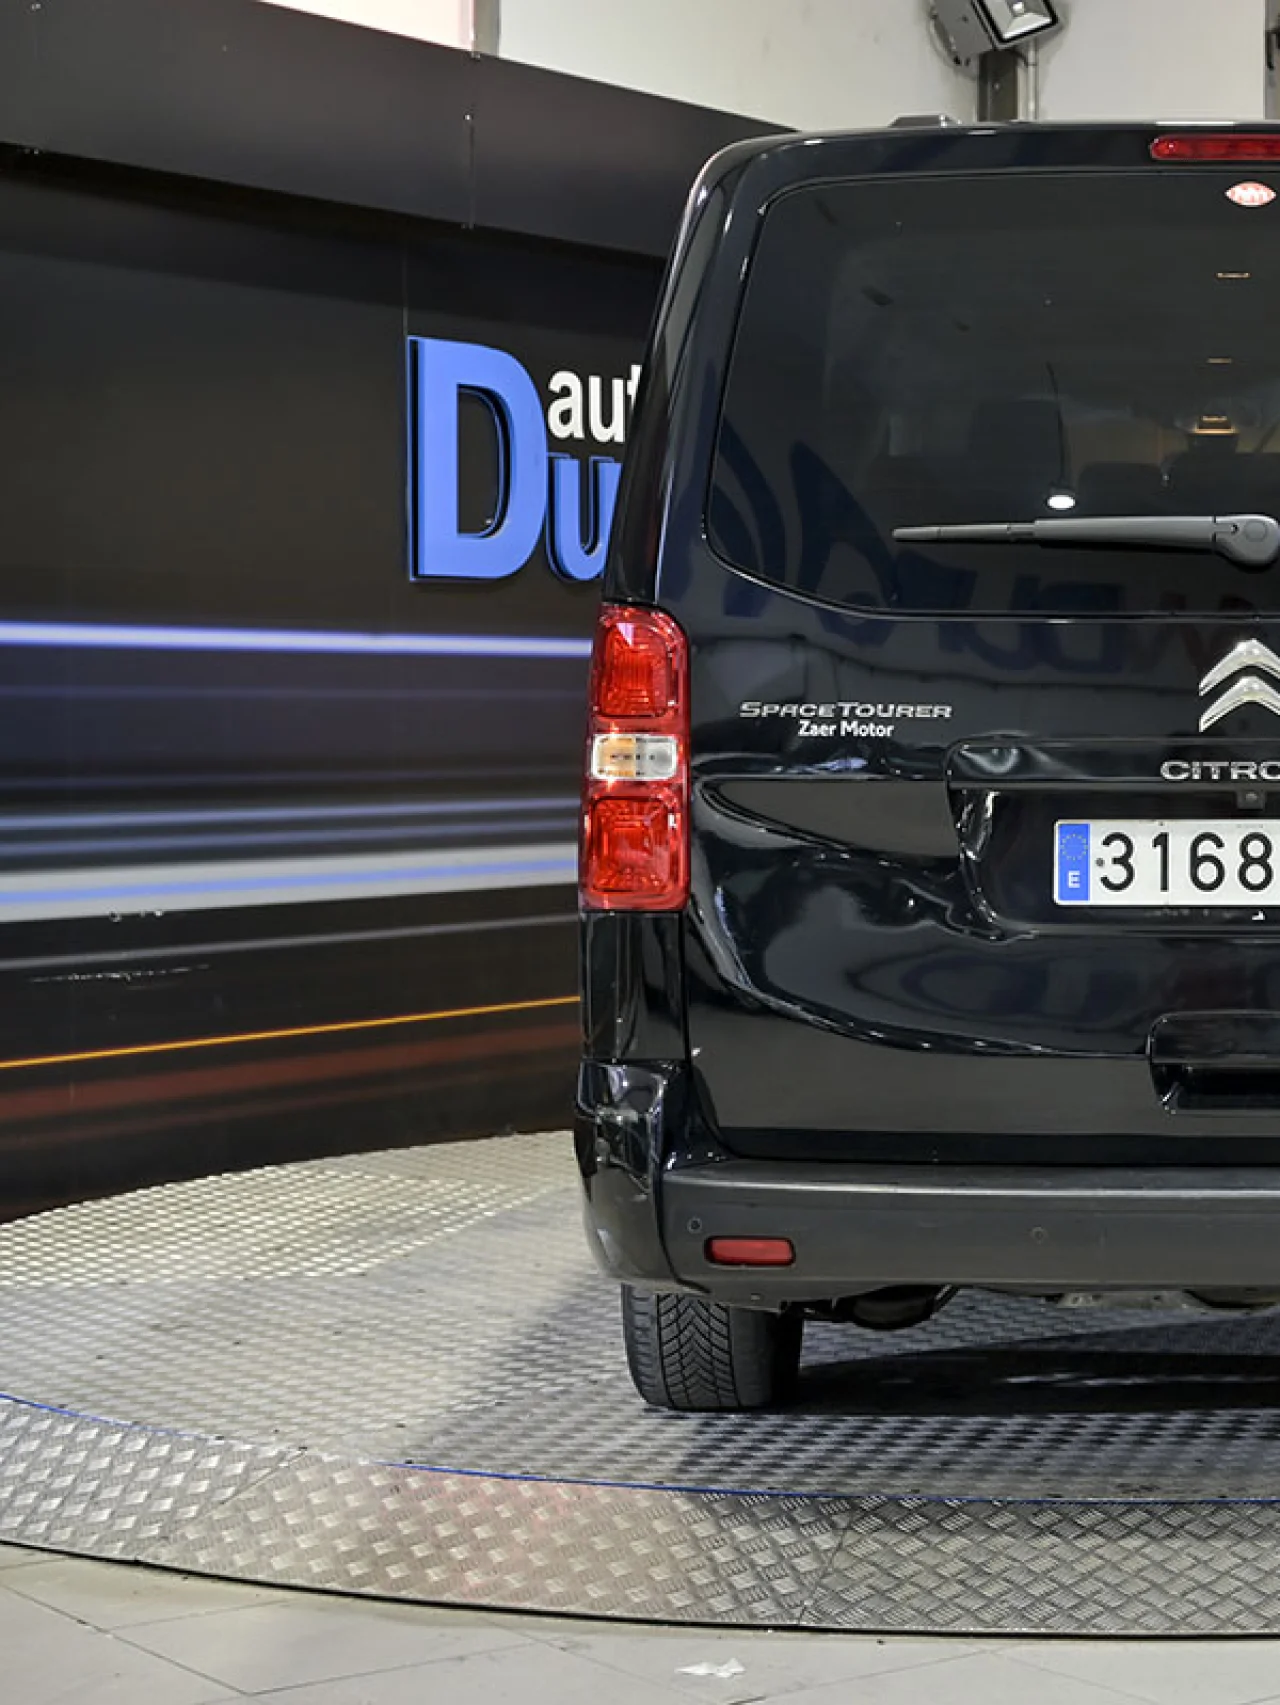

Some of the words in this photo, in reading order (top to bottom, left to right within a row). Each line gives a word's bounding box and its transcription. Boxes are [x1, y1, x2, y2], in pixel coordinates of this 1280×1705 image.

[798, 720, 837, 737] Zaer
[840, 720, 896, 737] Motor
[1099, 831, 1274, 893] 3168
[1067, 870, 1081, 888] E
